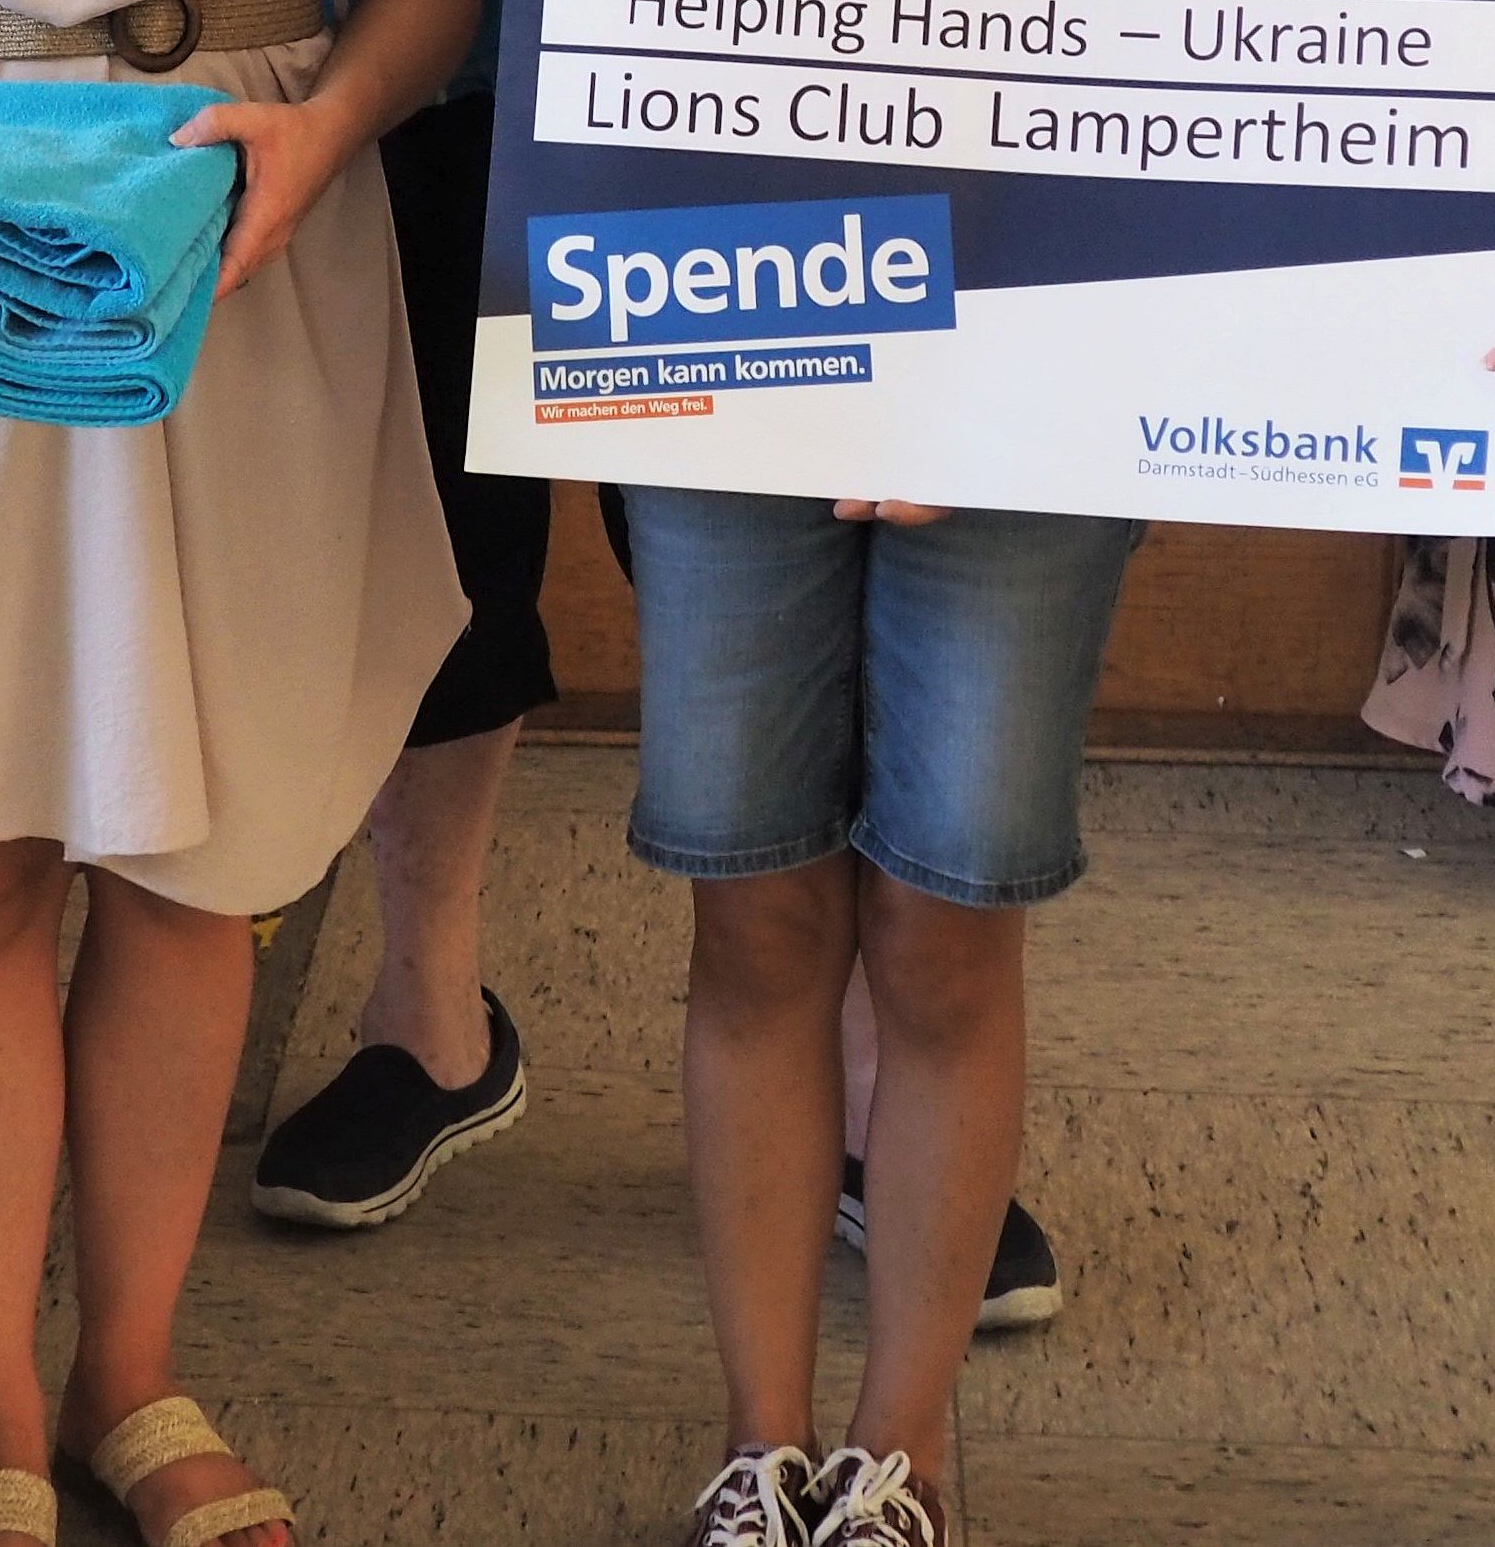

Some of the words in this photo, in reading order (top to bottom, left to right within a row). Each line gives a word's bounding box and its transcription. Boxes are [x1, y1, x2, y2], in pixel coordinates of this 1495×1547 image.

[1183, 5, 1433, 67] Ukraine
[587, 71, 761, 138] Lions
[789, 82, 944, 149] Club
[990, 90, 1470, 171] Lampertheim
[546, 213, 930, 343] Spende
[539, 365, 649, 395] Morgen
[657, 358, 727, 386] kann
[734, 353, 866, 382] kommen.
[540, 406, 564, 420] Wir
[567, 404, 618, 418] machen
[620, 401, 646, 415] den
[649, 400, 680, 416] Weg
[681, 398, 708, 412] frei.
[1138, 414, 1379, 464] Volksbank
[1354, 471, 1379, 488] eG
